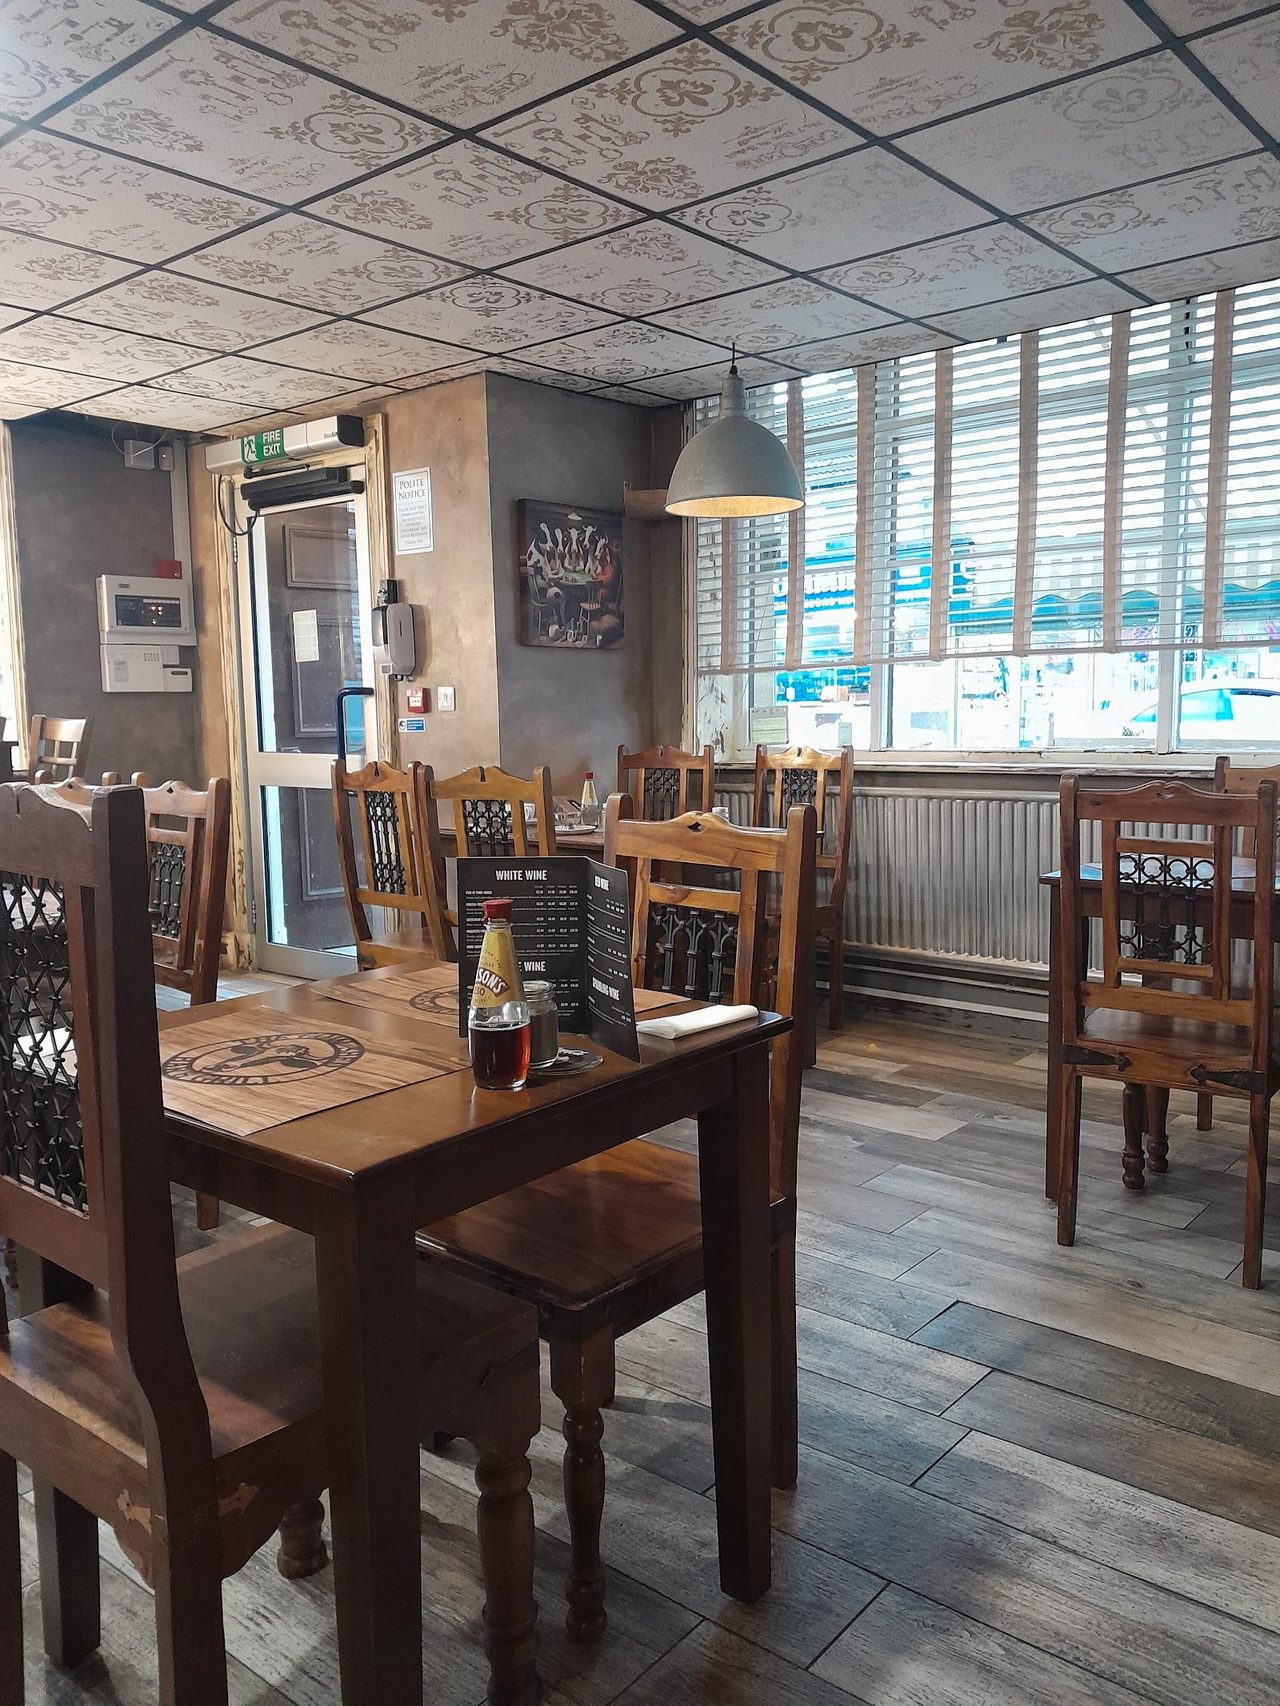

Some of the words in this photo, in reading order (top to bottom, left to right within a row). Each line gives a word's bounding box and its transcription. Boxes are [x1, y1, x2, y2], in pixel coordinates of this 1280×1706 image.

[262, 429, 281, 444] FIRE
[263, 443, 281, 457] EXIT
[399, 478, 424, 490] POLITE
[398, 489, 426, 501] NOTICE
[495, 870, 523, 881] WHITE
[524, 869, 548, 881] WINE
[523, 961, 547, 972] WINE
